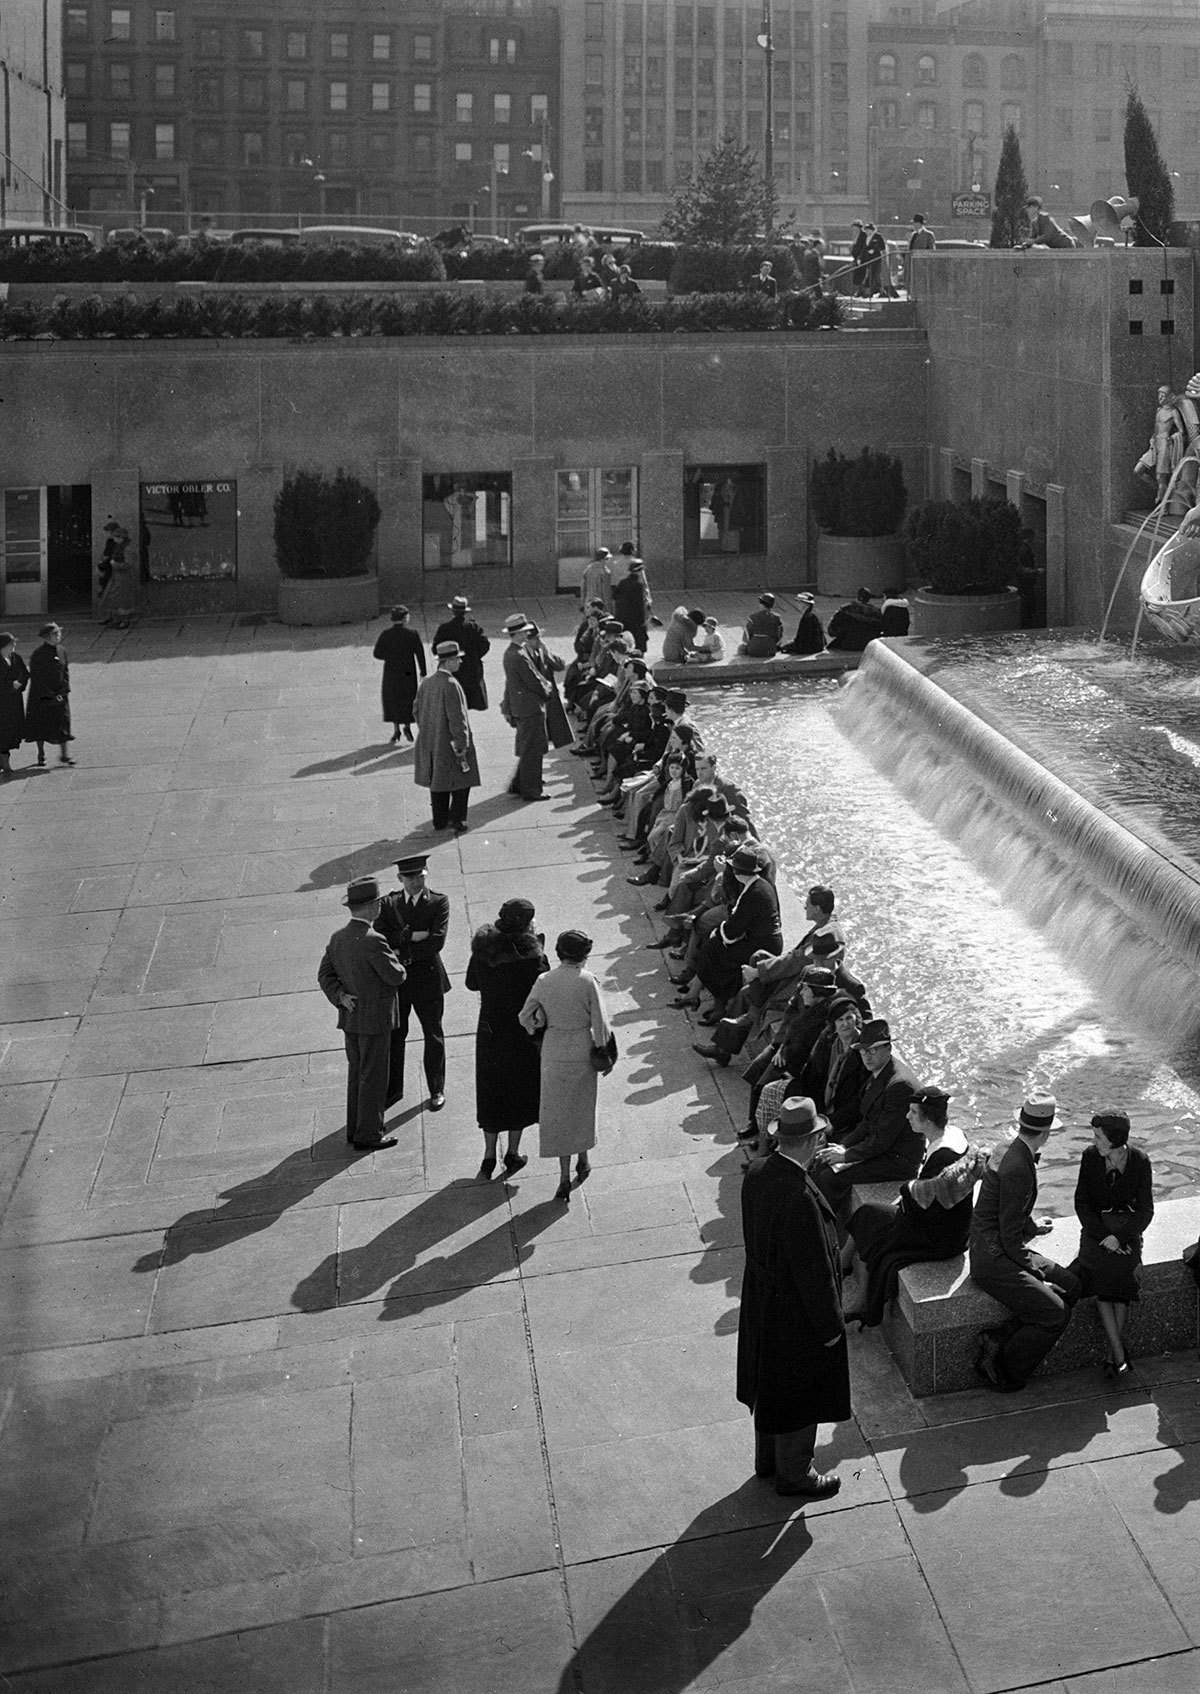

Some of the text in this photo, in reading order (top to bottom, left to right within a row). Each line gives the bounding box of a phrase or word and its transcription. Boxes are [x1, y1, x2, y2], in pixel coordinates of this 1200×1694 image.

[952, 200, 990, 208] PARKING
[956, 208, 986, 216] SPACE
[145, 483, 231, 494] VICTOR OBLER CO.
